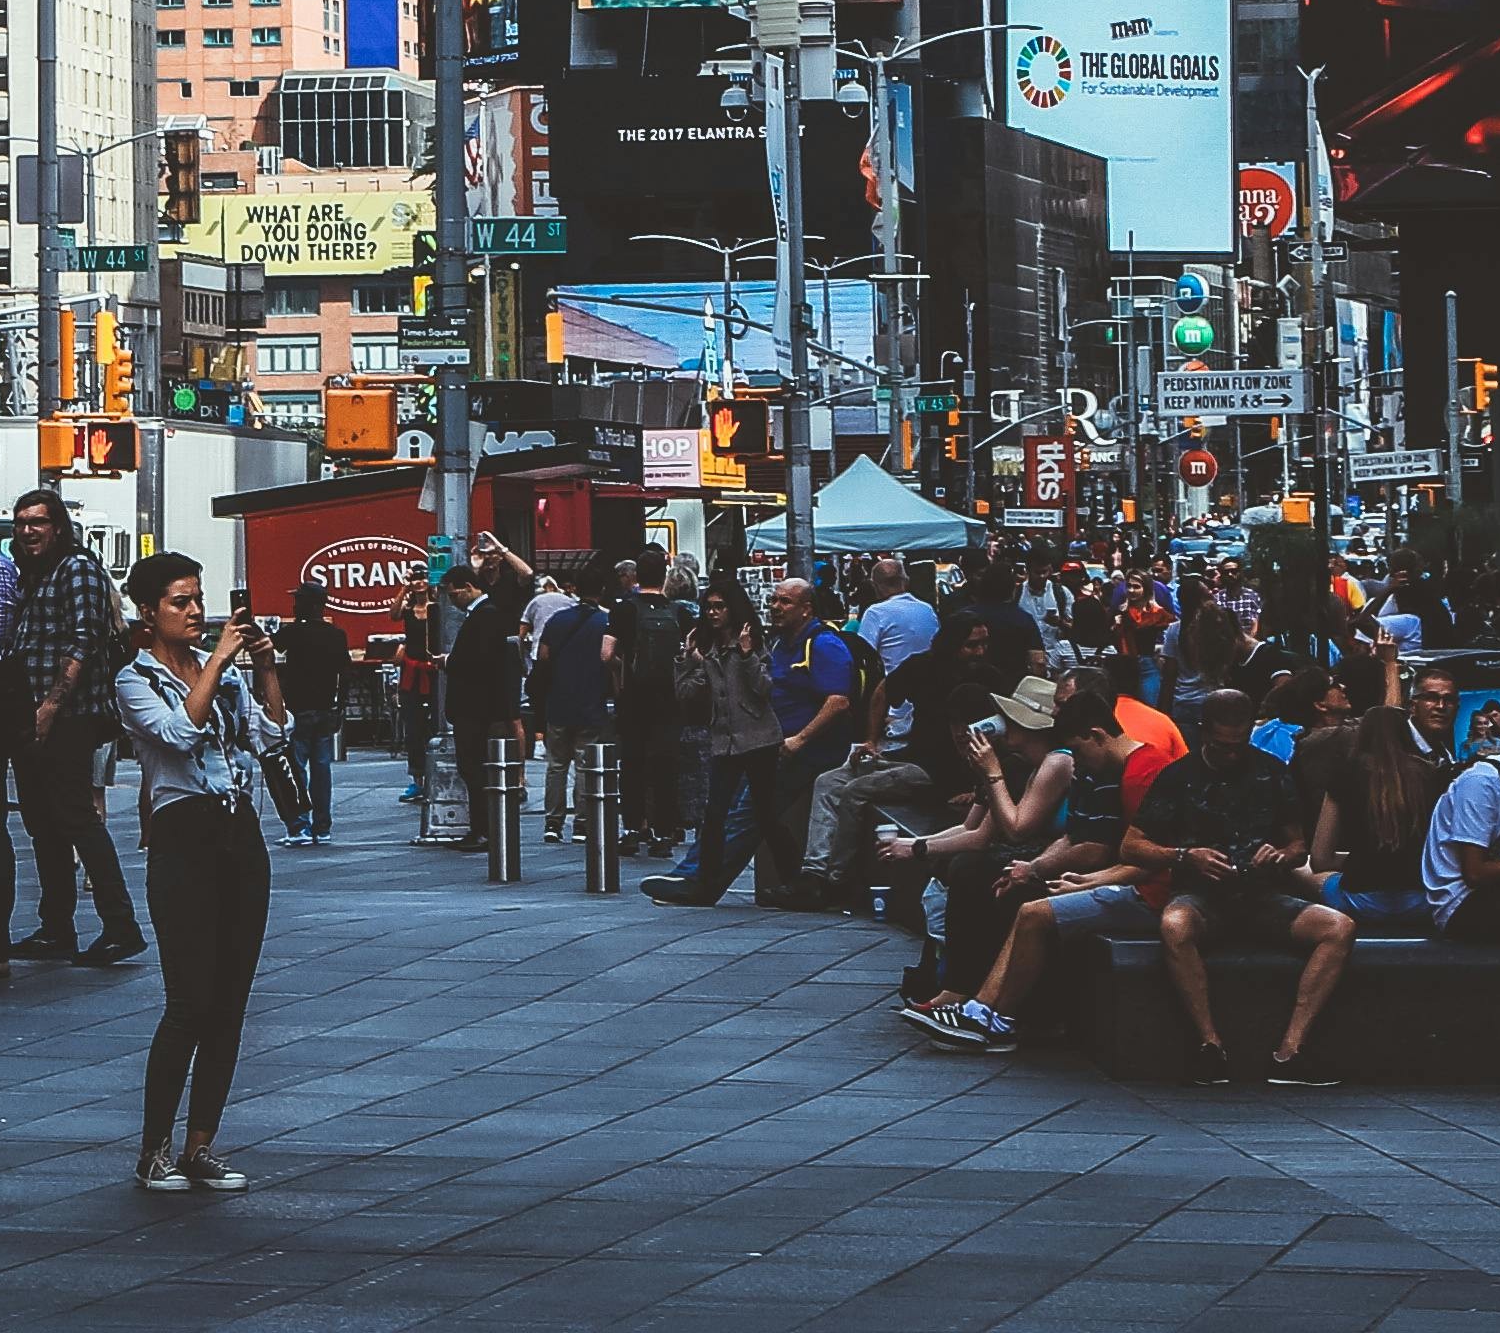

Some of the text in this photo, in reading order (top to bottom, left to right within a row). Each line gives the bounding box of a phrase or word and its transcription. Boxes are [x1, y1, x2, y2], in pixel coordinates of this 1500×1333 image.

[1080, 52, 1219, 81] THE GLOBAL GOALS
[1081, 81, 1219, 100] For Sustainable Development
[618, 130, 645, 142] THE
[650, 128, 683, 141] 2017
[688, 126, 755, 140] ELANTRA
[246, 204, 344, 224] WHAT ARE
[261, 222, 367, 243] YOU DOING
[476, 222, 561, 249] W 44 ST
[83, 250, 98, 269] W
[106, 249, 127, 269] 44
[241, 241, 377, 264] DOWN THERE?
[428, 328, 458, 337] Square
[1163, 375, 1293, 392] PEDESTRIAN FLOW ZONE
[917, 398, 943, 410] W 45
[1164, 394, 1236, 409] KEEP MOVING
[1036, 441, 1065, 501] tkts
